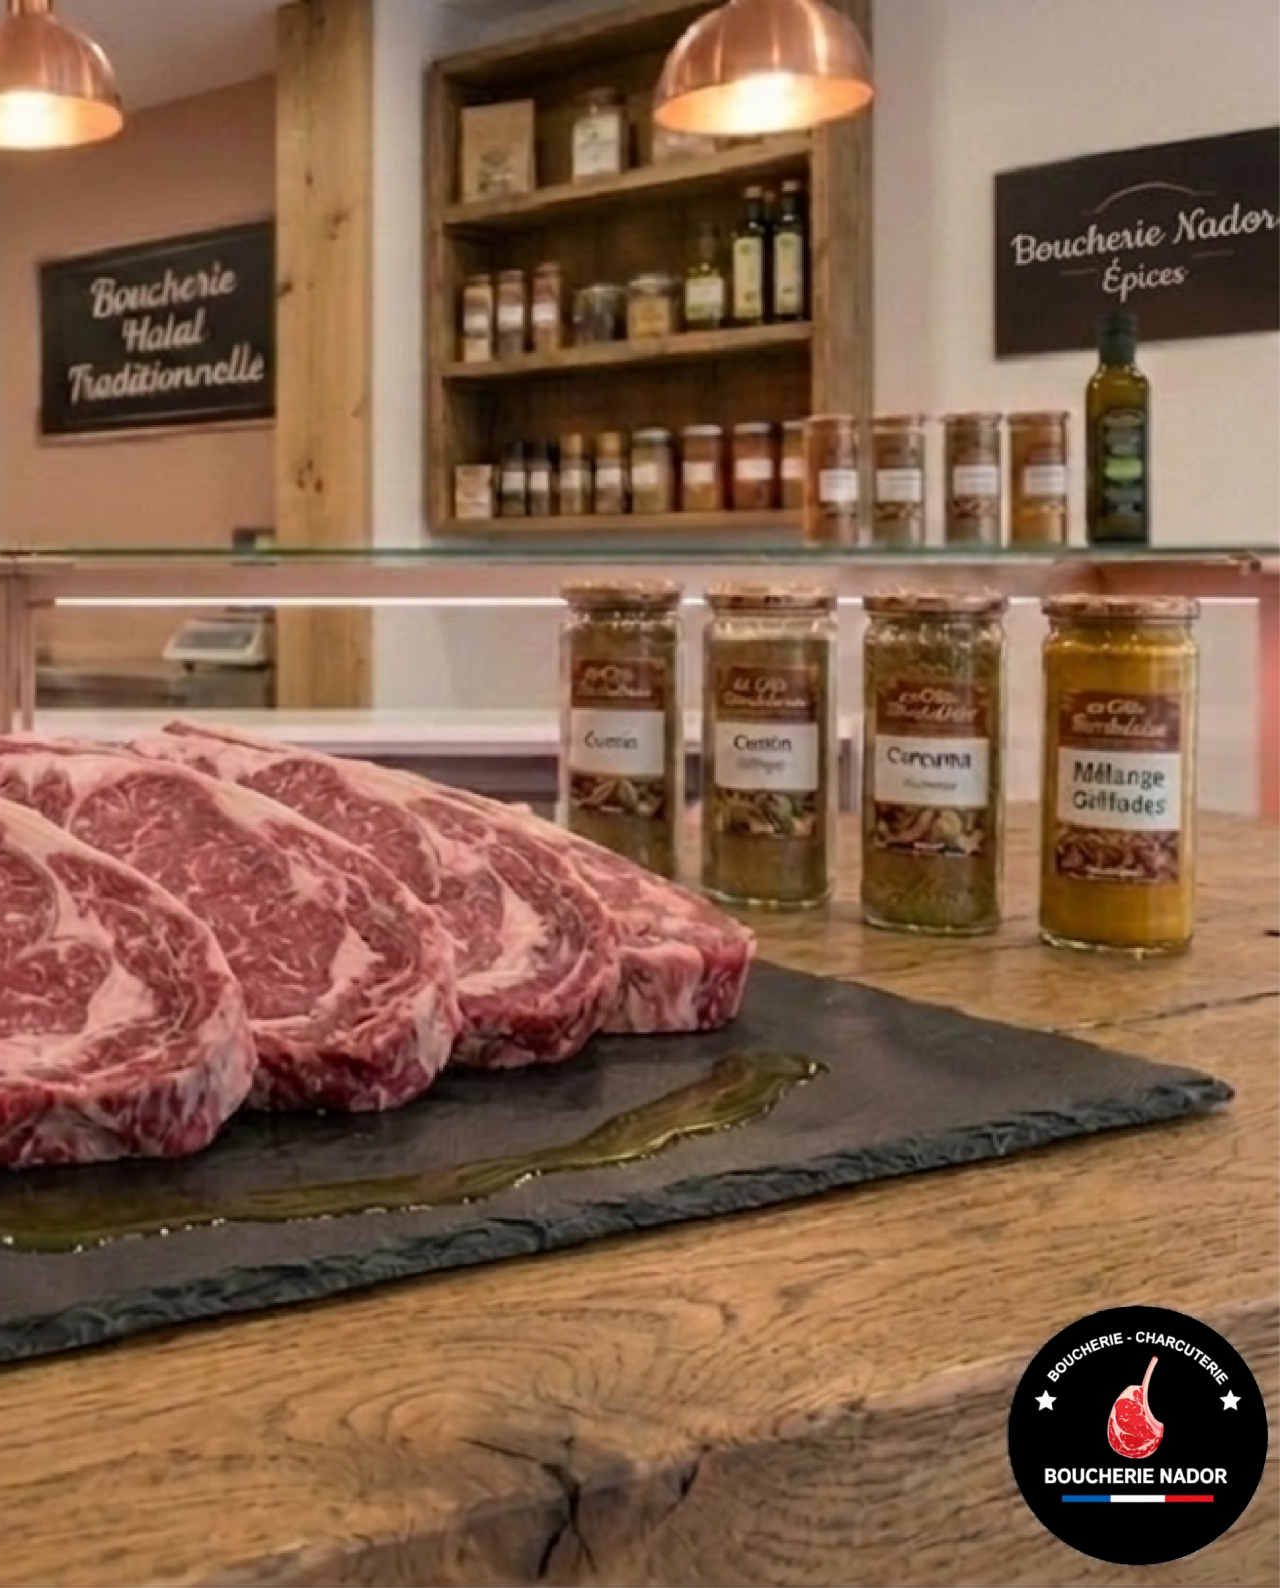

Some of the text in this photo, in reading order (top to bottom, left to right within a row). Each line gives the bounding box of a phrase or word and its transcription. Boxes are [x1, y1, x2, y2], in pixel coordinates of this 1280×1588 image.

[1011, 202, 1280, 266] Boucherie Nador
[90, 261, 237, 319] Boucherie
[1102, 256, 1188, 304] Épices
[122, 307, 206, 353] Halal
[68, 342, 265, 405] Traditionnelle
